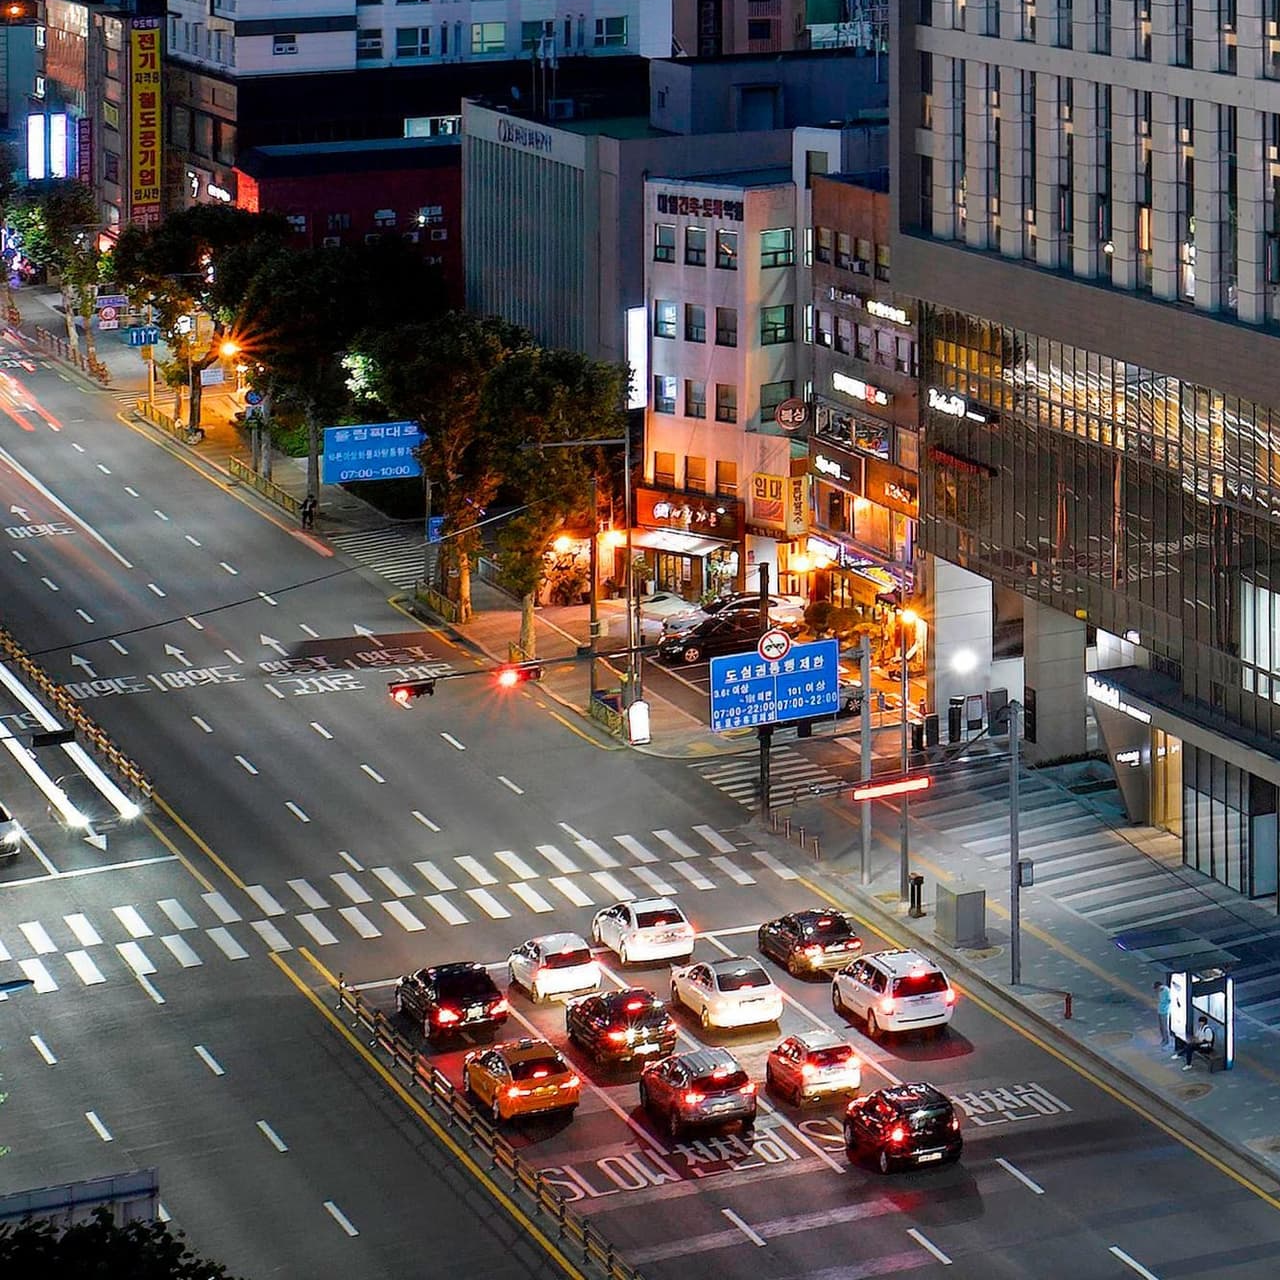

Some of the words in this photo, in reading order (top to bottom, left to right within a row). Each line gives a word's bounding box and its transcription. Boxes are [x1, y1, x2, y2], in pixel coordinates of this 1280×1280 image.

[138, 33, 156, 70] 전기
[138, 92, 156, 186] 철도공기업
[335, 426, 419, 443] 올림픽대로
[340, 465, 410, 480] 07:00~10:00
[755, 477, 782, 500] 임대
[5, 521, 78, 540] 여의도
[259, 655, 343, 677] 영등포
[356, 645, 443, 666] 영등포
[156, 665, 246, 689] 여의도
[726, 655, 824, 681] 도심권통행제한
[65, 675, 151, 700] 여의도
[732, 683, 749, 694] 이상
[805, 679, 826, 693] 이상
[949, 1081, 1073, 1127] 천천히
[672, 1126, 801, 1178] 천천히
[535, 1151, 684, 1203] SLOW
